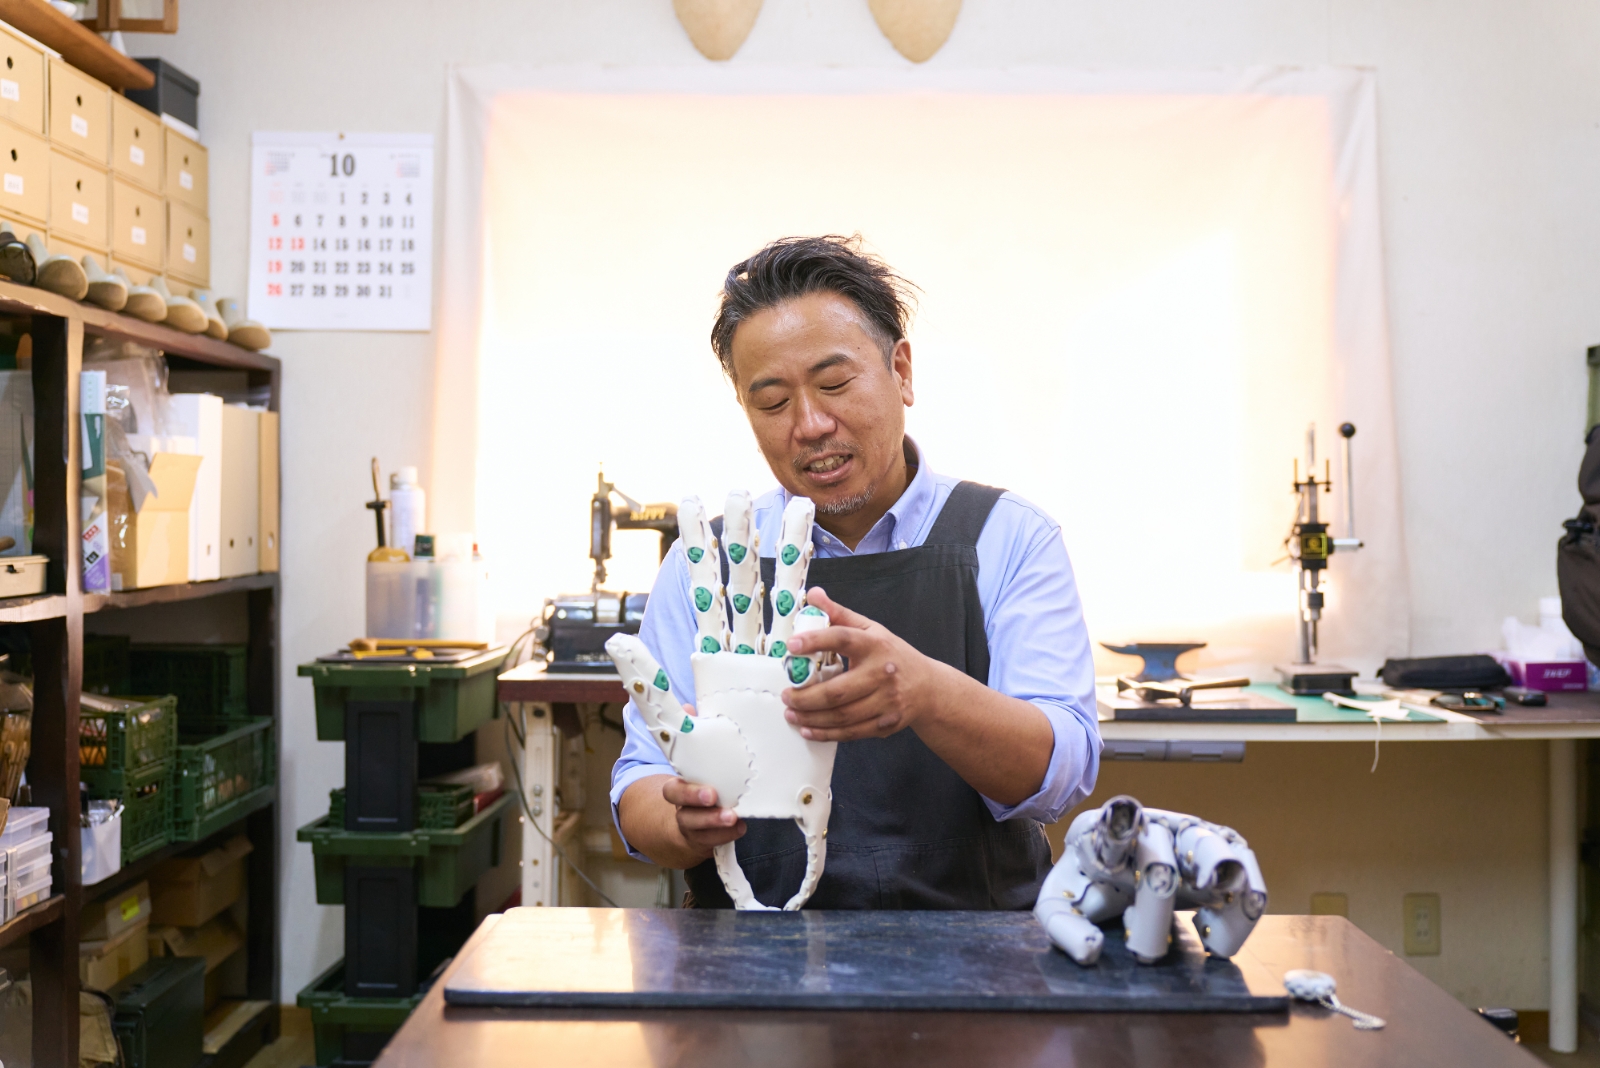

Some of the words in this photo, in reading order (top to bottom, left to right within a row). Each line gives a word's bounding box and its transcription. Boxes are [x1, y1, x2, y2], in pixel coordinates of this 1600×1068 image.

[330, 153, 356, 178] 10
[339, 191, 346, 206] 1
[361, 191, 369, 206] 2
[382, 191, 391, 206] 3
[405, 192, 413, 206] 4
[271, 213, 281, 228] 5
[293, 214, 303, 228] 6
[316, 213, 325, 229] 7
[338, 214, 347, 229] 8
[360, 215, 369, 229] 9
[379, 215, 394, 229] 10
[401, 215, 415, 230] 11
[268, 236, 284, 251] 12
[290, 237, 306, 251] 13
[313, 238, 327, 251] 14
[335, 237, 350, 252] 15
[357, 238, 372, 252] 16
[378, 238, 393, 252] 17
[401, 238, 415, 252] 18
[267, 259, 283, 274] 19
[290, 260, 306, 274] 20
[312, 260, 327, 275] 21
[334, 260, 350, 275] 22
[356, 261, 372, 275] 23
[378, 261, 394, 276] 24
[400, 261, 416, 276] 25
[267, 282, 283, 297] 26
[289, 283, 306, 298] 27
[312, 284, 327, 298] 28
[334, 284, 350, 298] 29
[355, 284, 372, 298] 30
[378, 284, 393, 299] 31
